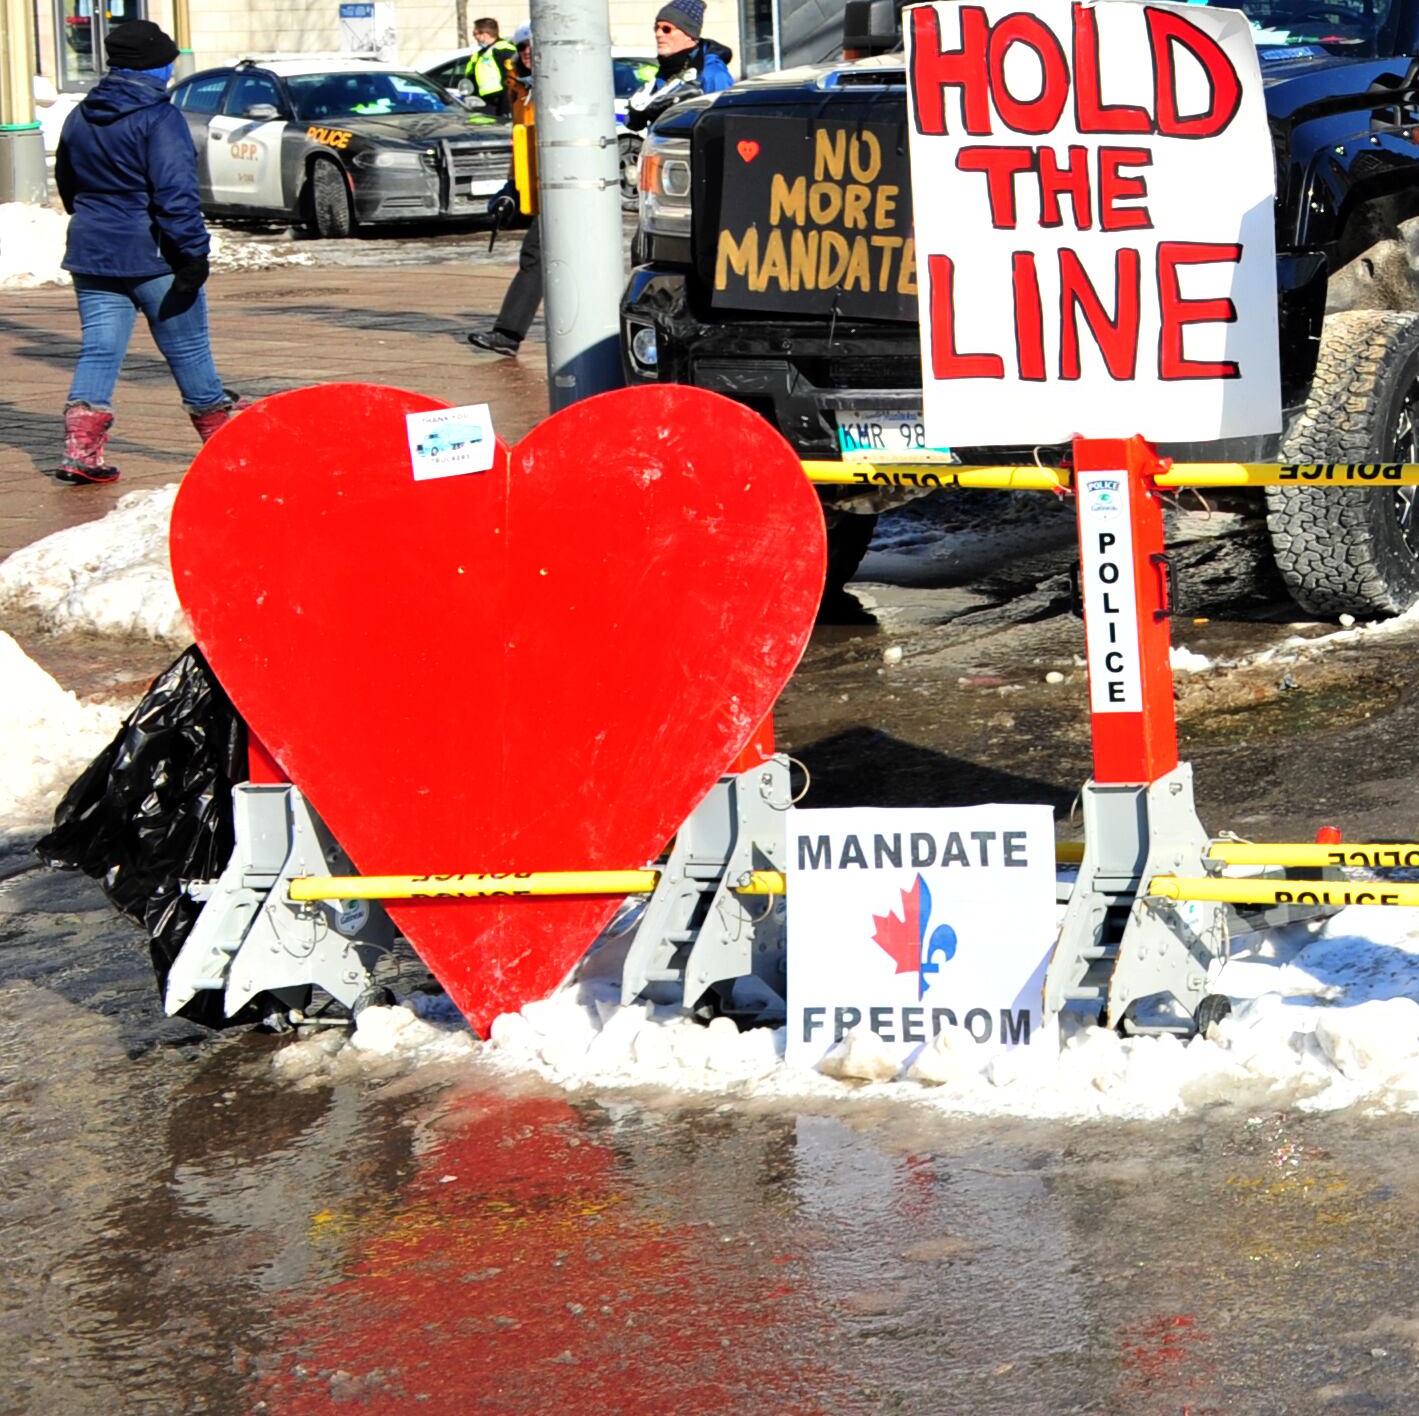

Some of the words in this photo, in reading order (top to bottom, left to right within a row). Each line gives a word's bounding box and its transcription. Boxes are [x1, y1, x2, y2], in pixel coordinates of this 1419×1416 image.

[909, 2, 1243, 139] HOLD
[306, 125, 352, 148] POLICE
[813, 128, 881, 183] NO
[770, 174, 898, 228] MORE
[956, 145, 1155, 232] THE
[928, 242, 1244, 382] LINE
[841, 423, 886, 449] KMR
[1279, 464, 1403, 480] POLICE
[1098, 532, 1127, 703] POLICE
[796, 830, 1028, 870] MANDATE
[801, 1005, 1032, 1046] FREEDOM
